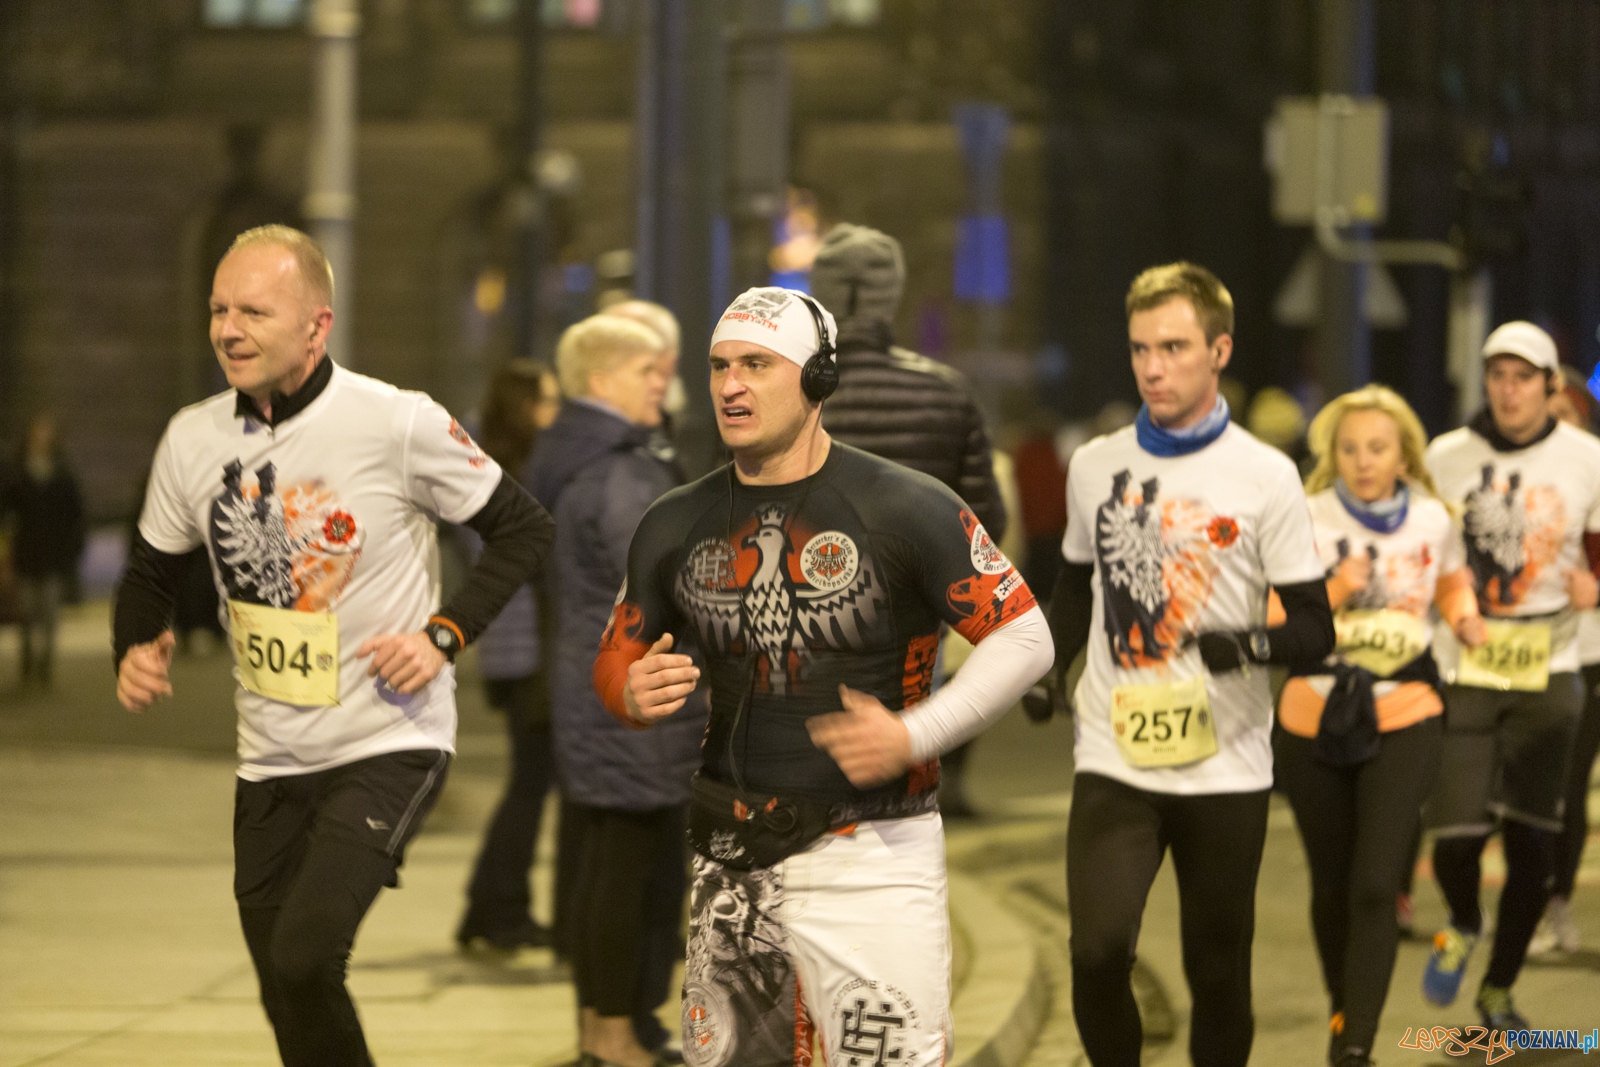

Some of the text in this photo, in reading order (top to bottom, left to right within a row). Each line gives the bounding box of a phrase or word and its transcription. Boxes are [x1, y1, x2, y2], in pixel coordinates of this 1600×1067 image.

[840, 538, 853, 555] Team
[805, 567, 854, 588] Wielkopolska
[247, 632, 313, 678] 504
[1350, 624, 1407, 658] 503
[1129, 706, 1192, 743] 257
